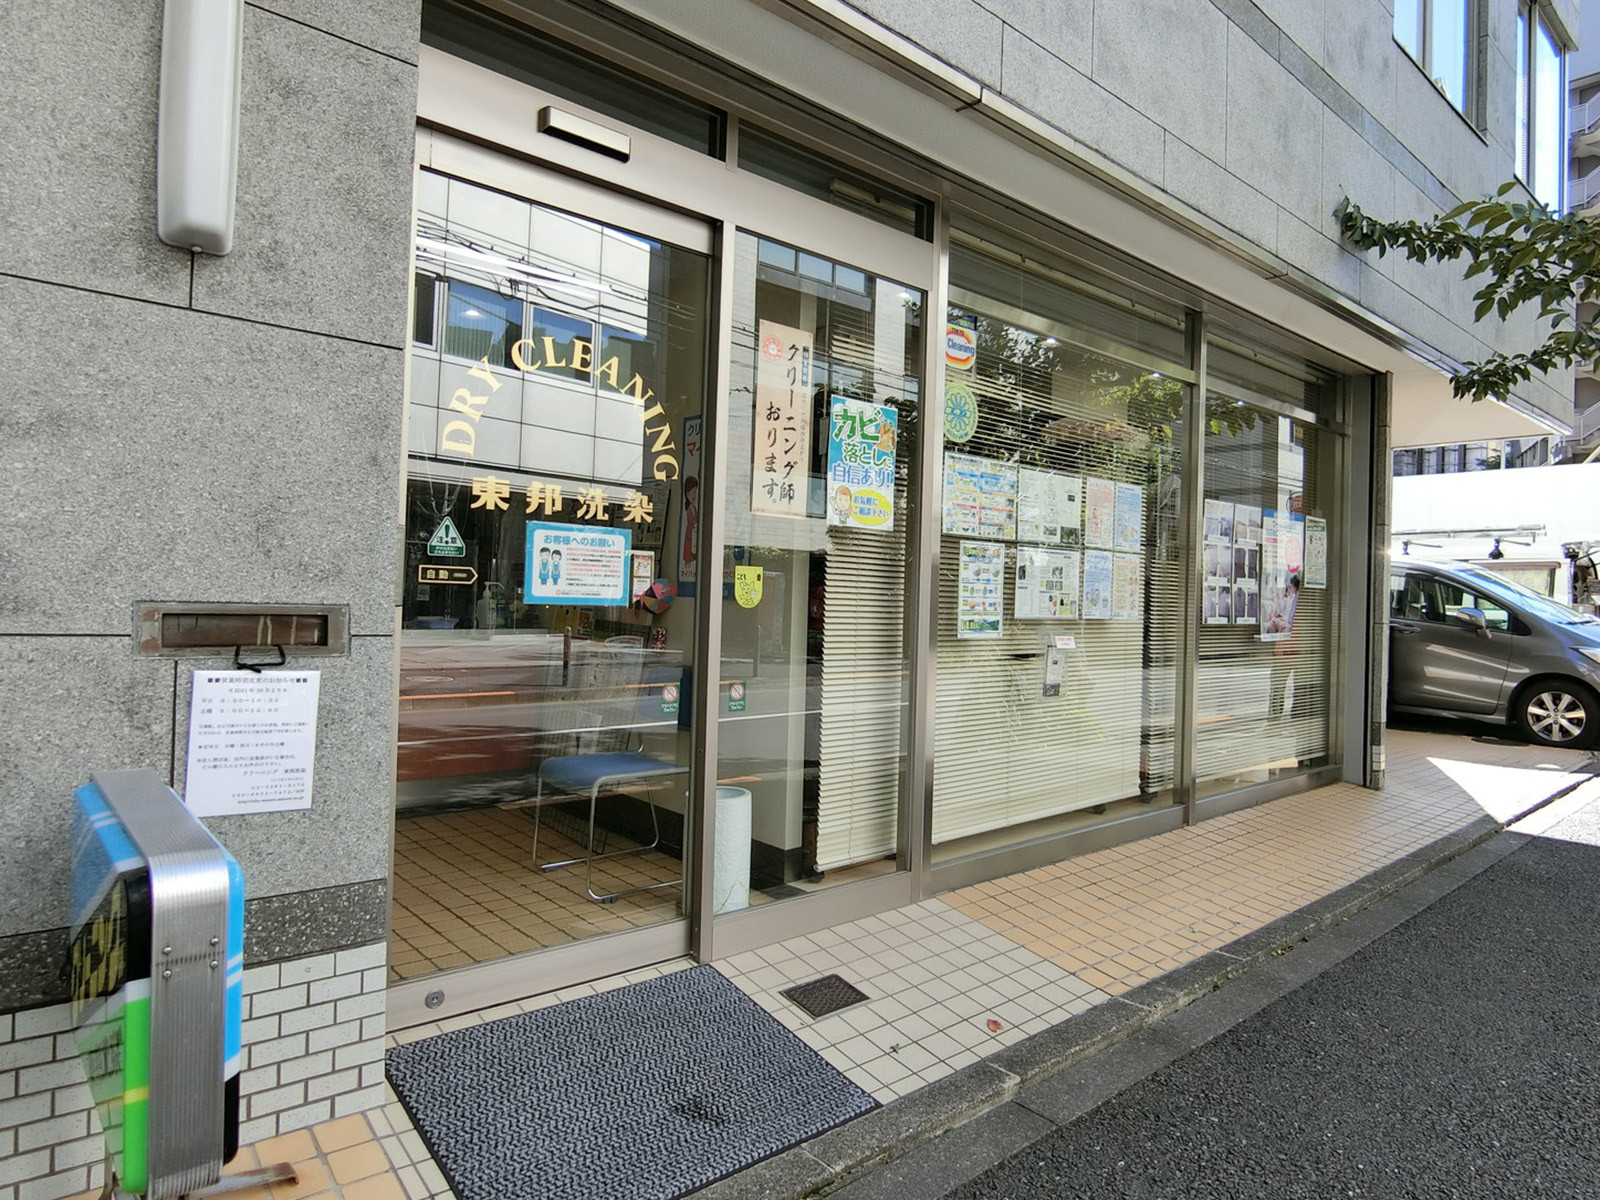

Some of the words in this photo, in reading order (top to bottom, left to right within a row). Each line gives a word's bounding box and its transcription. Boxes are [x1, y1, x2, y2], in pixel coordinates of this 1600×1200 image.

[947, 337, 975, 358] Cleaning
[441, 355, 503, 457] DRY
[510, 335, 680, 483] CLEANING
[779, 342, 800, 505] クリーニング師
[833, 408, 883, 442] カビ
[843, 443, 892, 469] 落としに
[470, 475, 655, 524] 東邦洗染
[852, 506, 890, 519] ご相談下さい
[853, 494, 878, 506] お気軽に
[543, 534, 616, 548] お客様へのお願い
